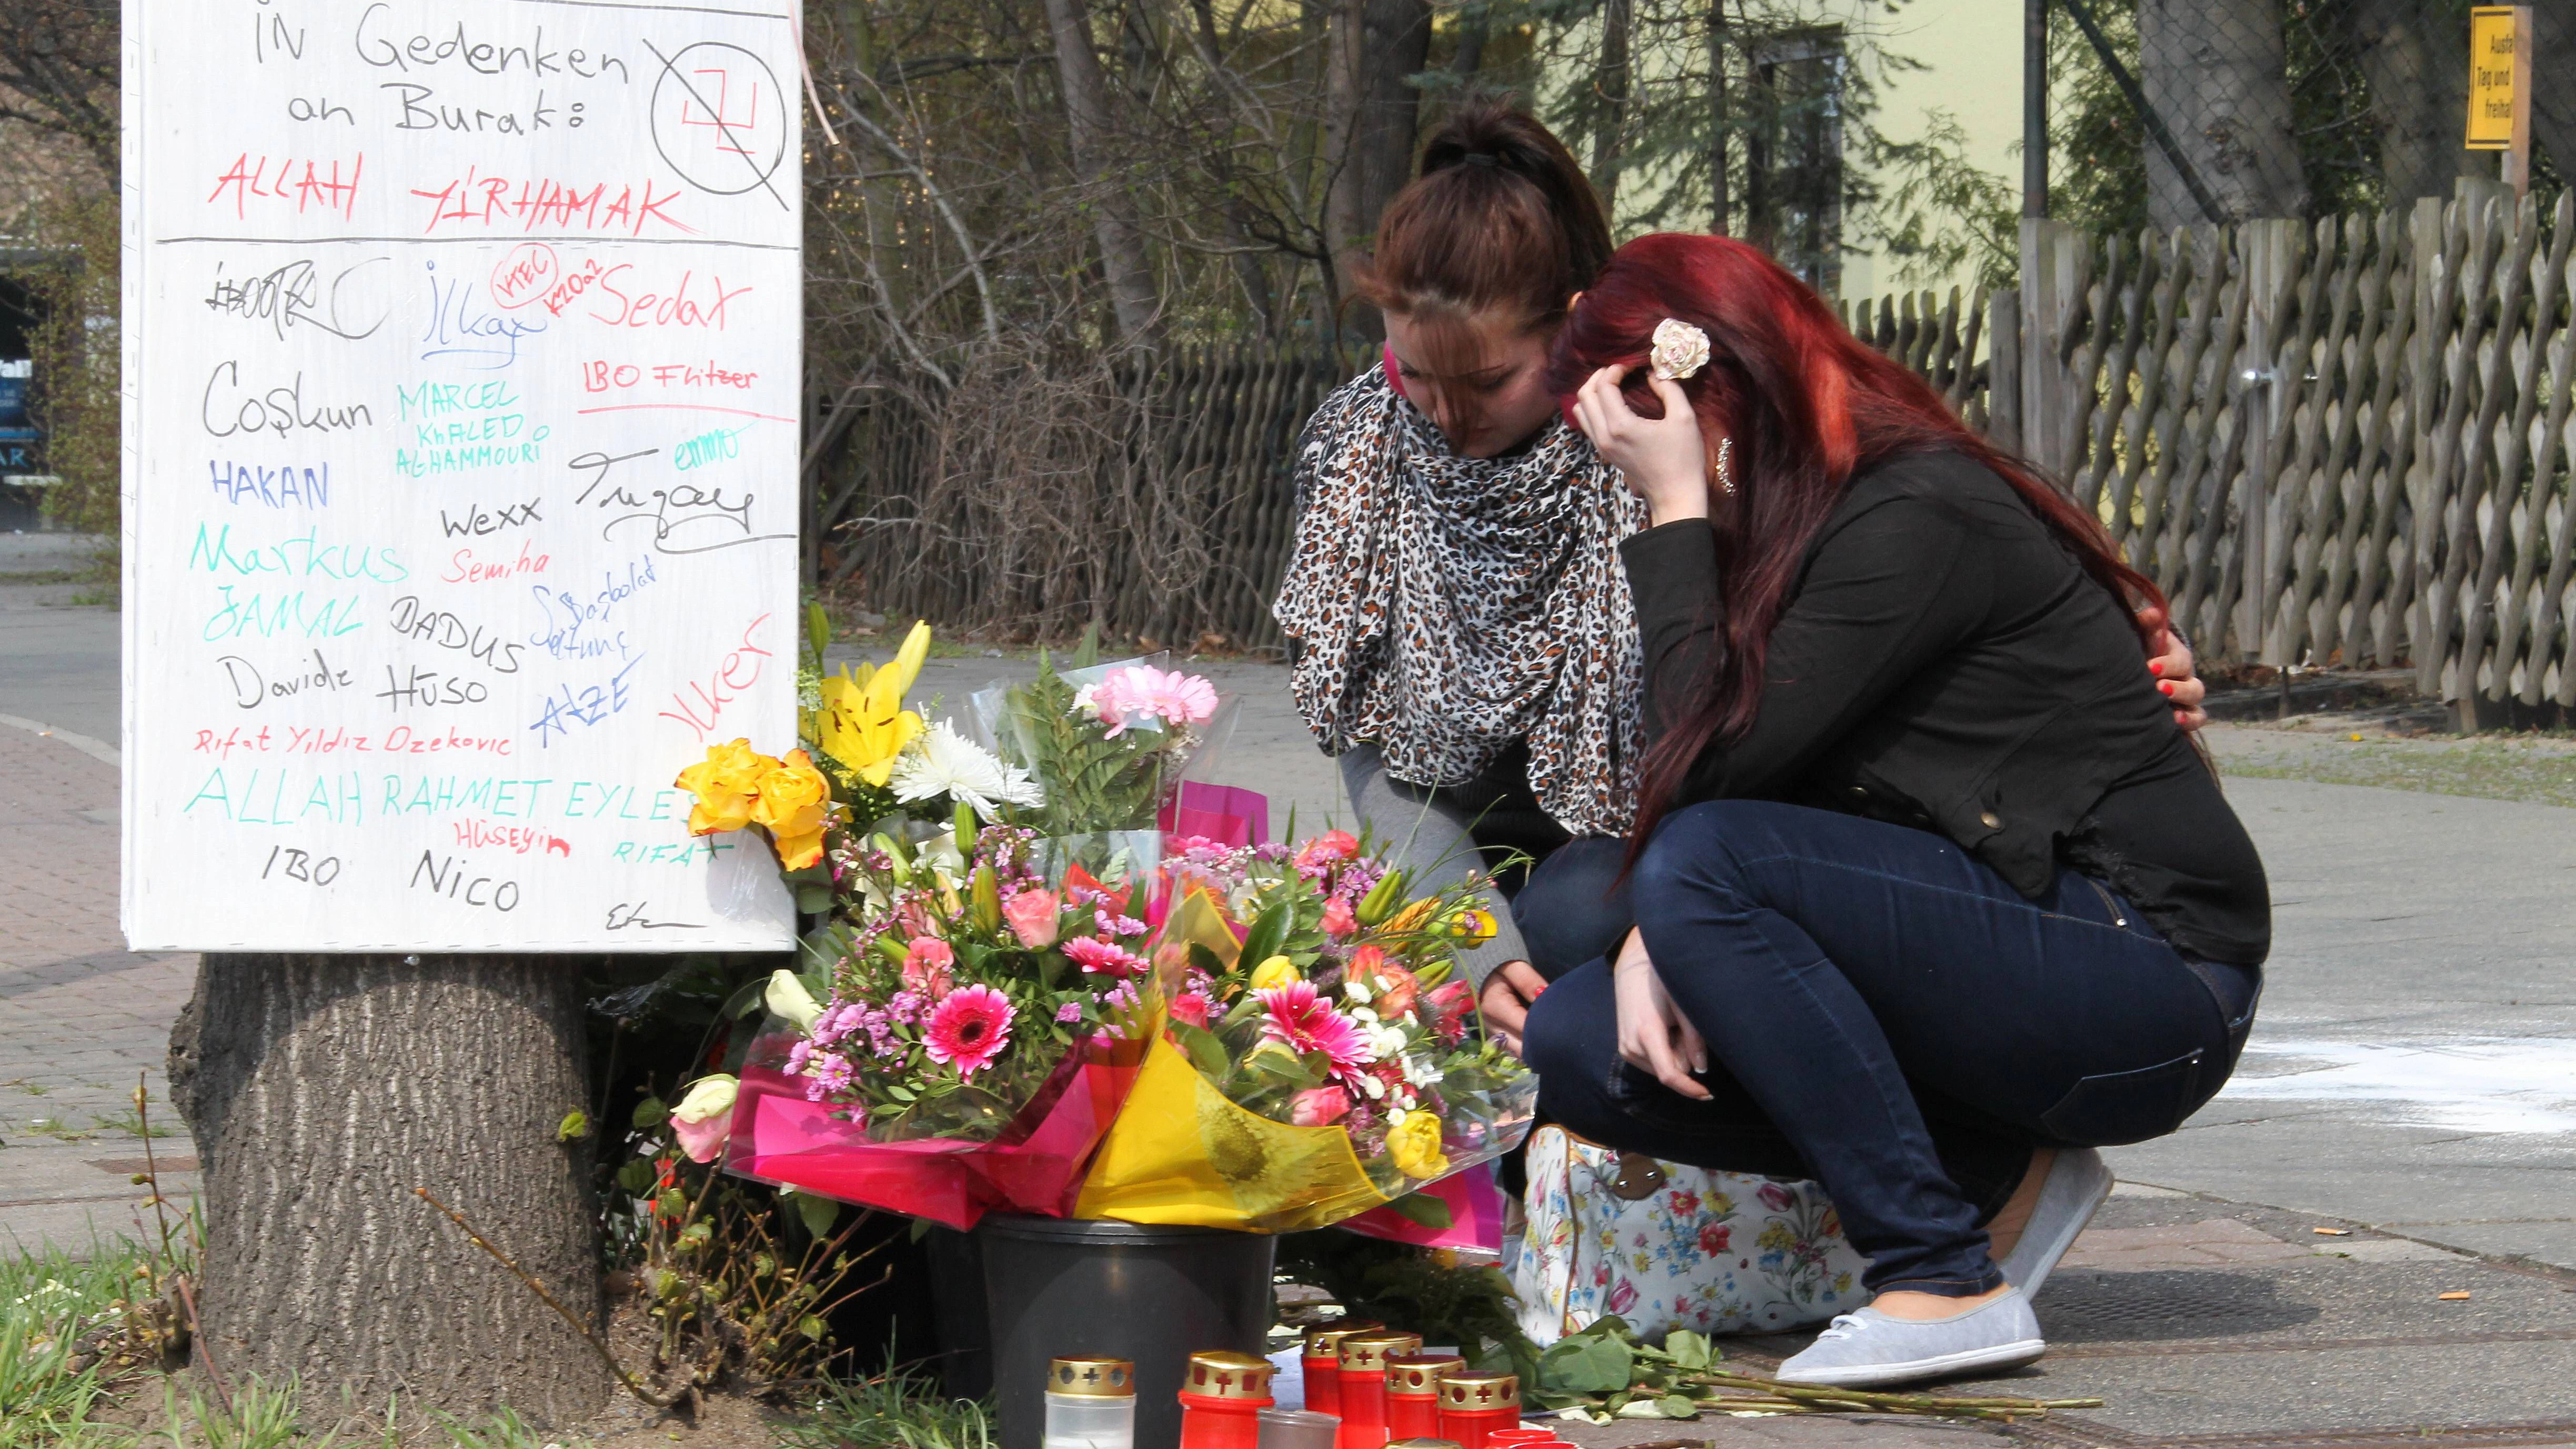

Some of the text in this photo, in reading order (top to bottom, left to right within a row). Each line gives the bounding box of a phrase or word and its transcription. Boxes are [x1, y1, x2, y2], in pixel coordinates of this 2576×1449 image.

[356, 3, 629, 85] Gedenken
[288, 97, 355, 125] an
[207, 151, 363, 223] ALLAH
[589, 263, 753, 331] Sedat
[396, 379, 520, 422] MARCEL
[209, 459, 328, 510] HAKAN
[189, 520, 409, 584] Markus
[440, 538, 550, 583] Semiha
[183, 767, 363, 827] ALLAH
[381, 774, 555, 818] RAHMET
[262, 845, 340, 887] IBO
